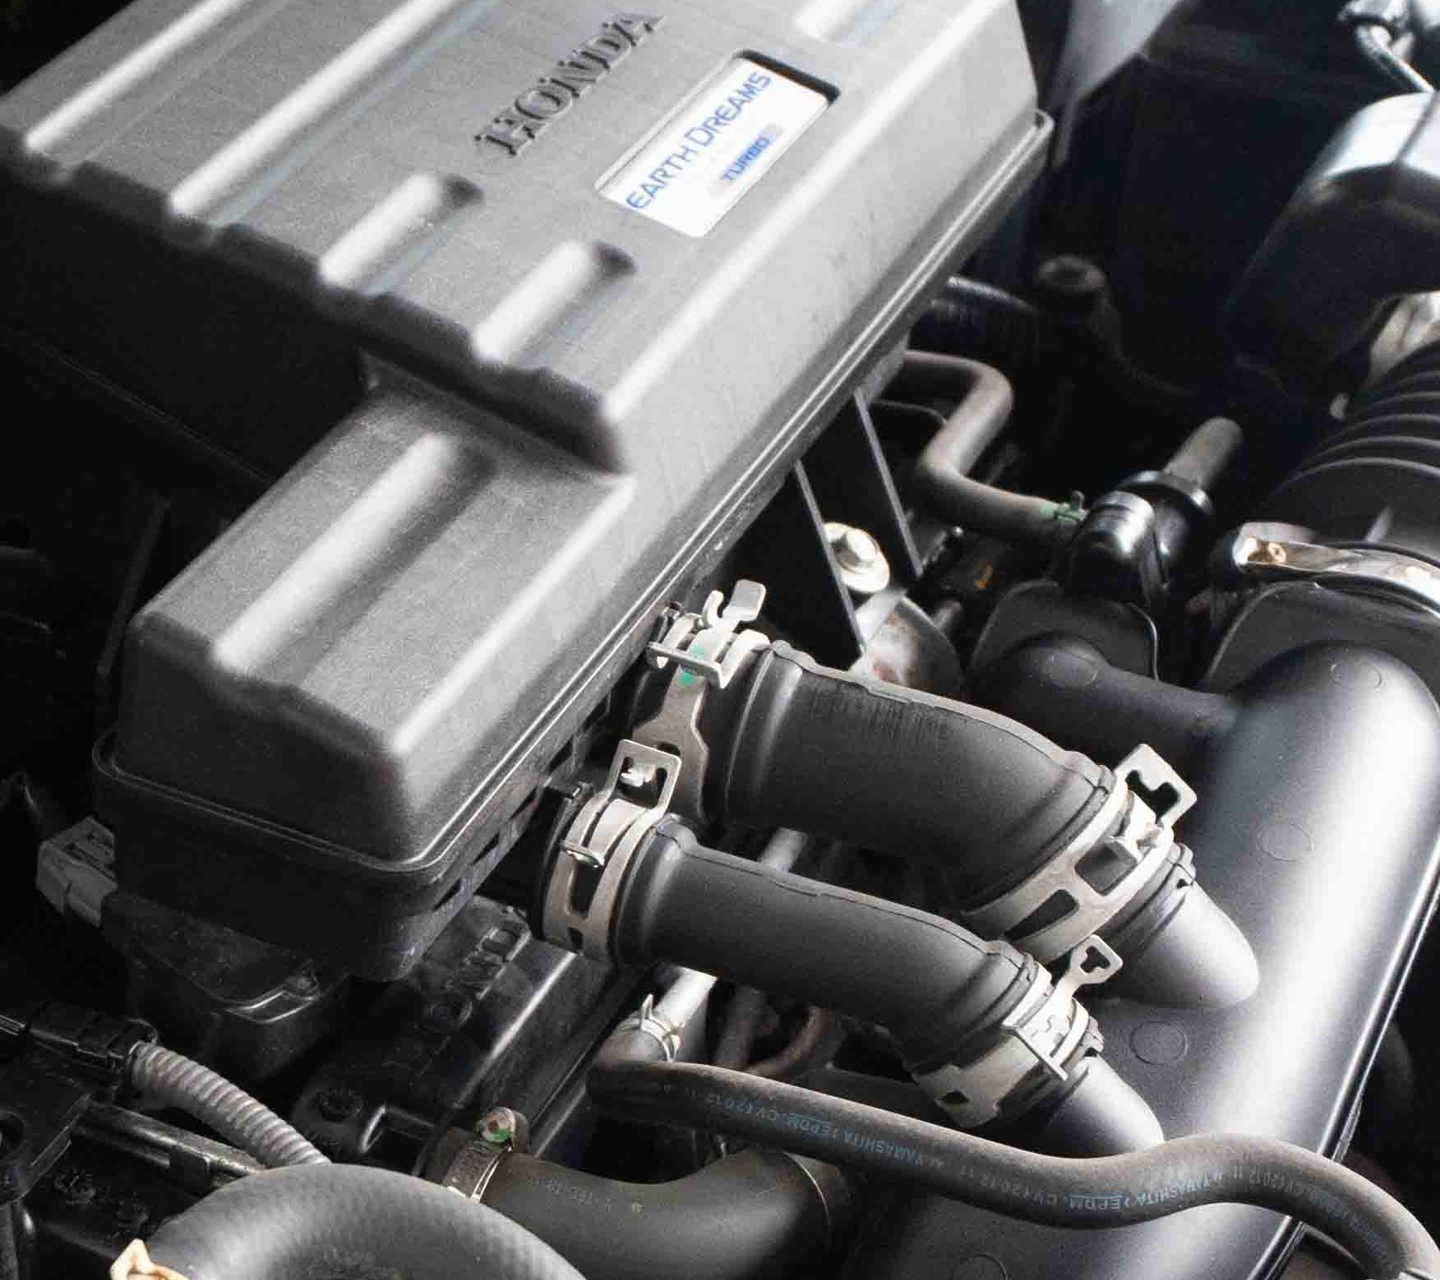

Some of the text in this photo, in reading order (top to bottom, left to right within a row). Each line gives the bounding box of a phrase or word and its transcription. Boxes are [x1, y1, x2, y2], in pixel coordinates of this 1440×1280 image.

[473, 10, 665, 157] HONDA
[625, 71, 772, 210] EARTH DREAMS
[721, 135, 771, 181] TURBO
